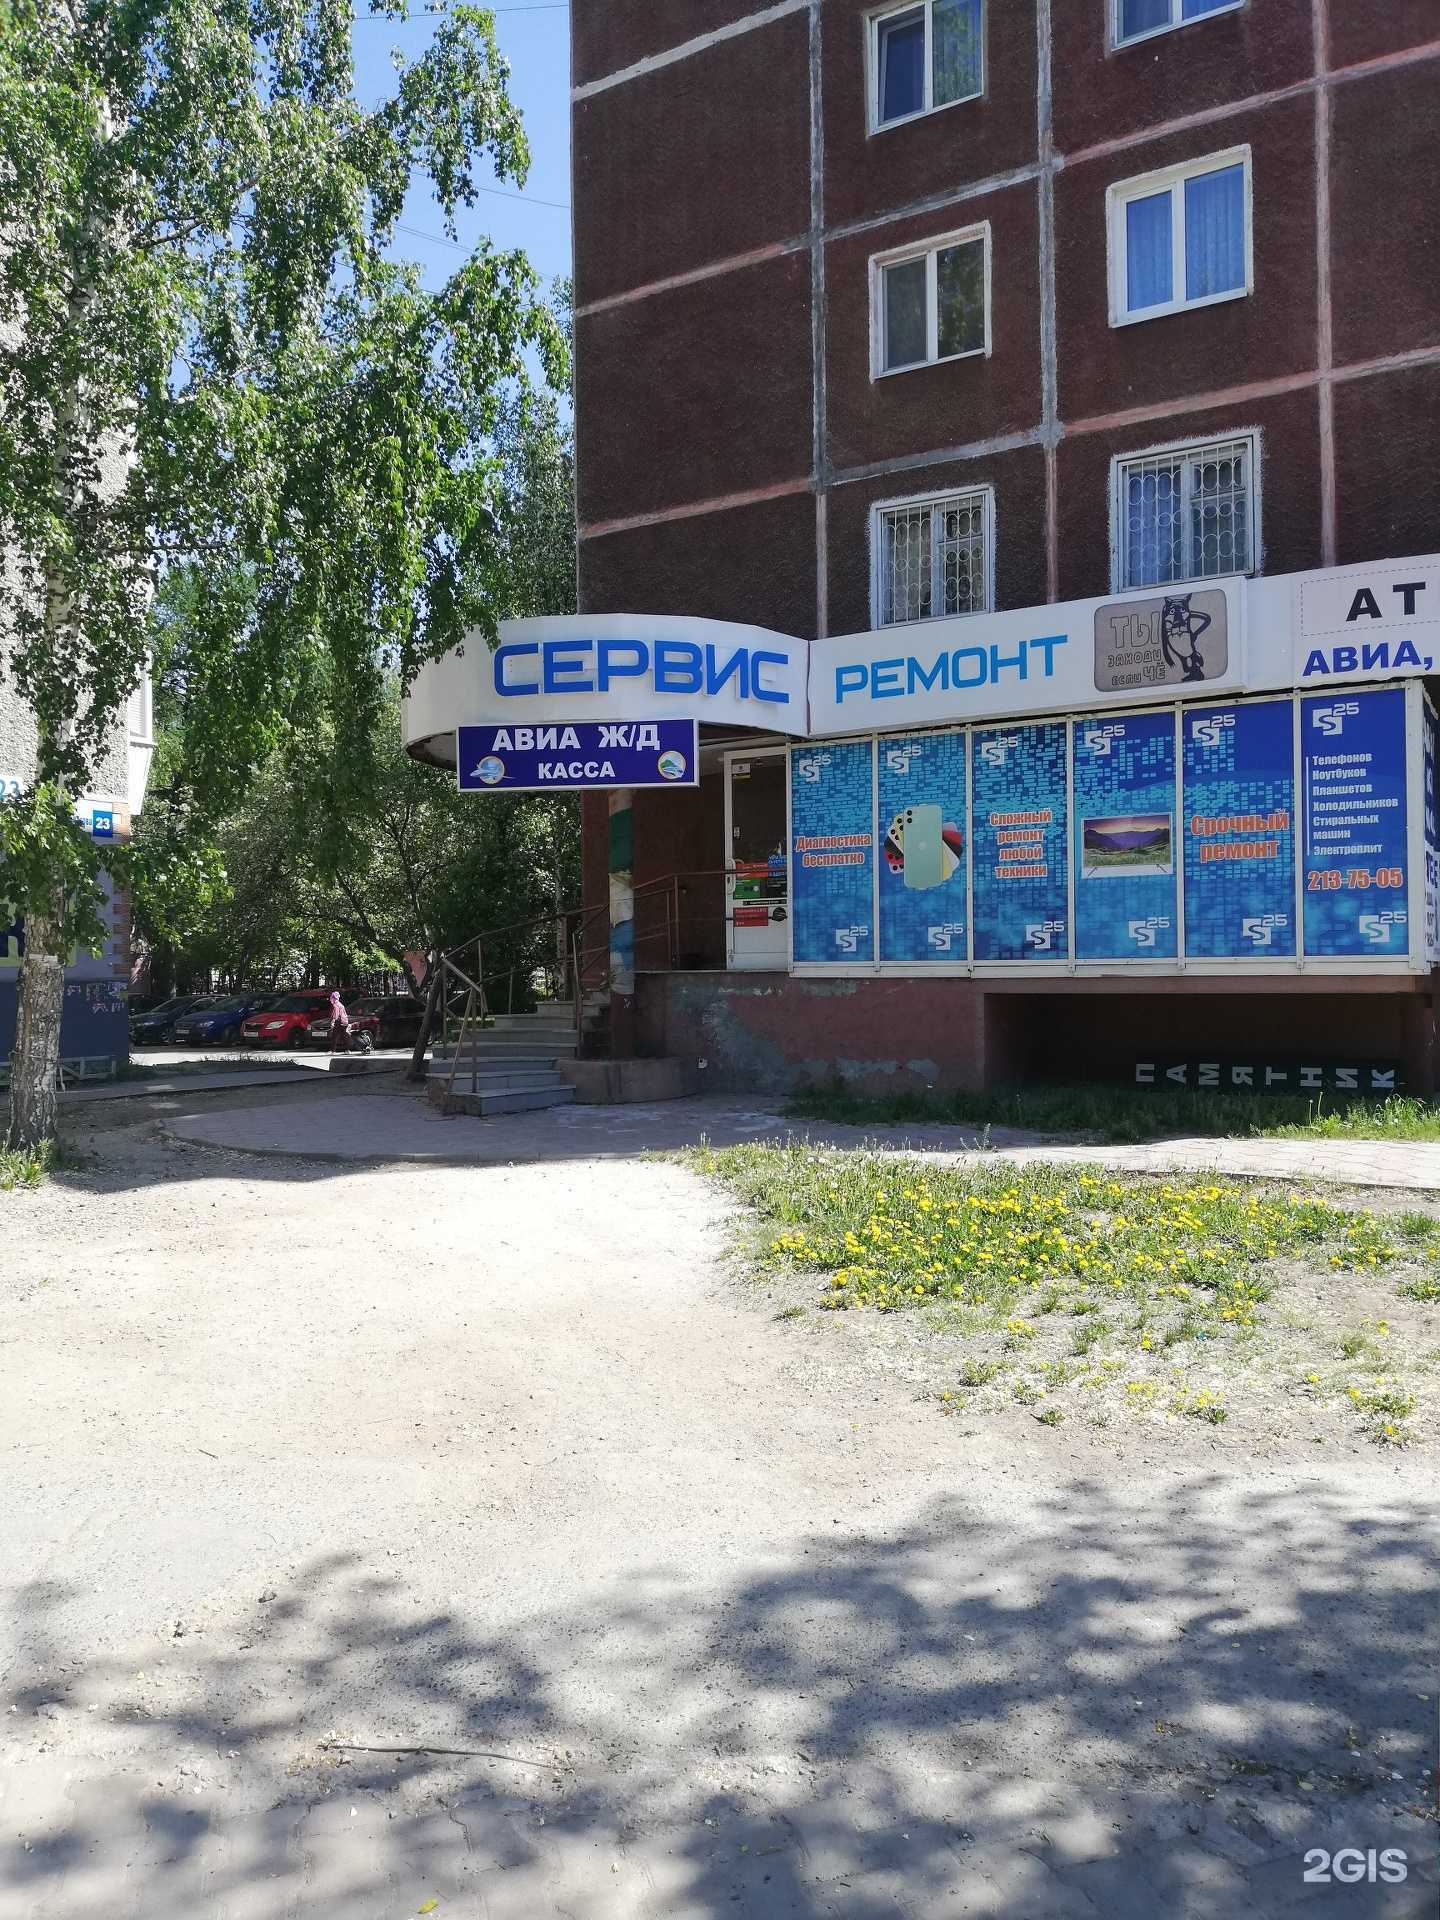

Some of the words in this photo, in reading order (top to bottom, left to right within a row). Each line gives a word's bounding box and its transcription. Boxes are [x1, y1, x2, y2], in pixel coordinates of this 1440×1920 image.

[1111, 611, 1160, 649] ТЫ
[1302, 640, 1433, 677] АВИА,
[493, 639, 790, 704] СЕРВИС
[835, 634, 1069, 704] РЕМОНТ
[492, 727, 582, 752] АВИА
[598, 724, 661, 751] Ж/Д
[1312, 752, 1373, 766] Телефонов
[538, 760, 616, 780] КАССА
[1312, 768, 1367, 780] Ноутбуков
[1312, 783, 1373, 797] Планшетов
[1312, 797, 1399, 812] Холодильников
[95, 816, 111, 830] 23
[989, 808, 1052, 827] Сложный
[1190, 808, 1290, 836] Срочный
[1312, 814, 1380, 827] Стиральных
[796, 834, 872, 852] Диагностика
[997, 828, 1044, 845] ремонт
[1313, 829, 1351, 840] машин
[999, 844, 1043, 861] любой
[1200, 839, 1280, 863] ремонт
[1313, 843, 1384, 856] Электроплит
[802, 852, 865, 867] бесплатно
[995, 864, 1048, 879] техники
[1307, 867, 1404, 891] 213-75-05
[1136, 1063, 1395, 1089] ПАМЯТНИК
